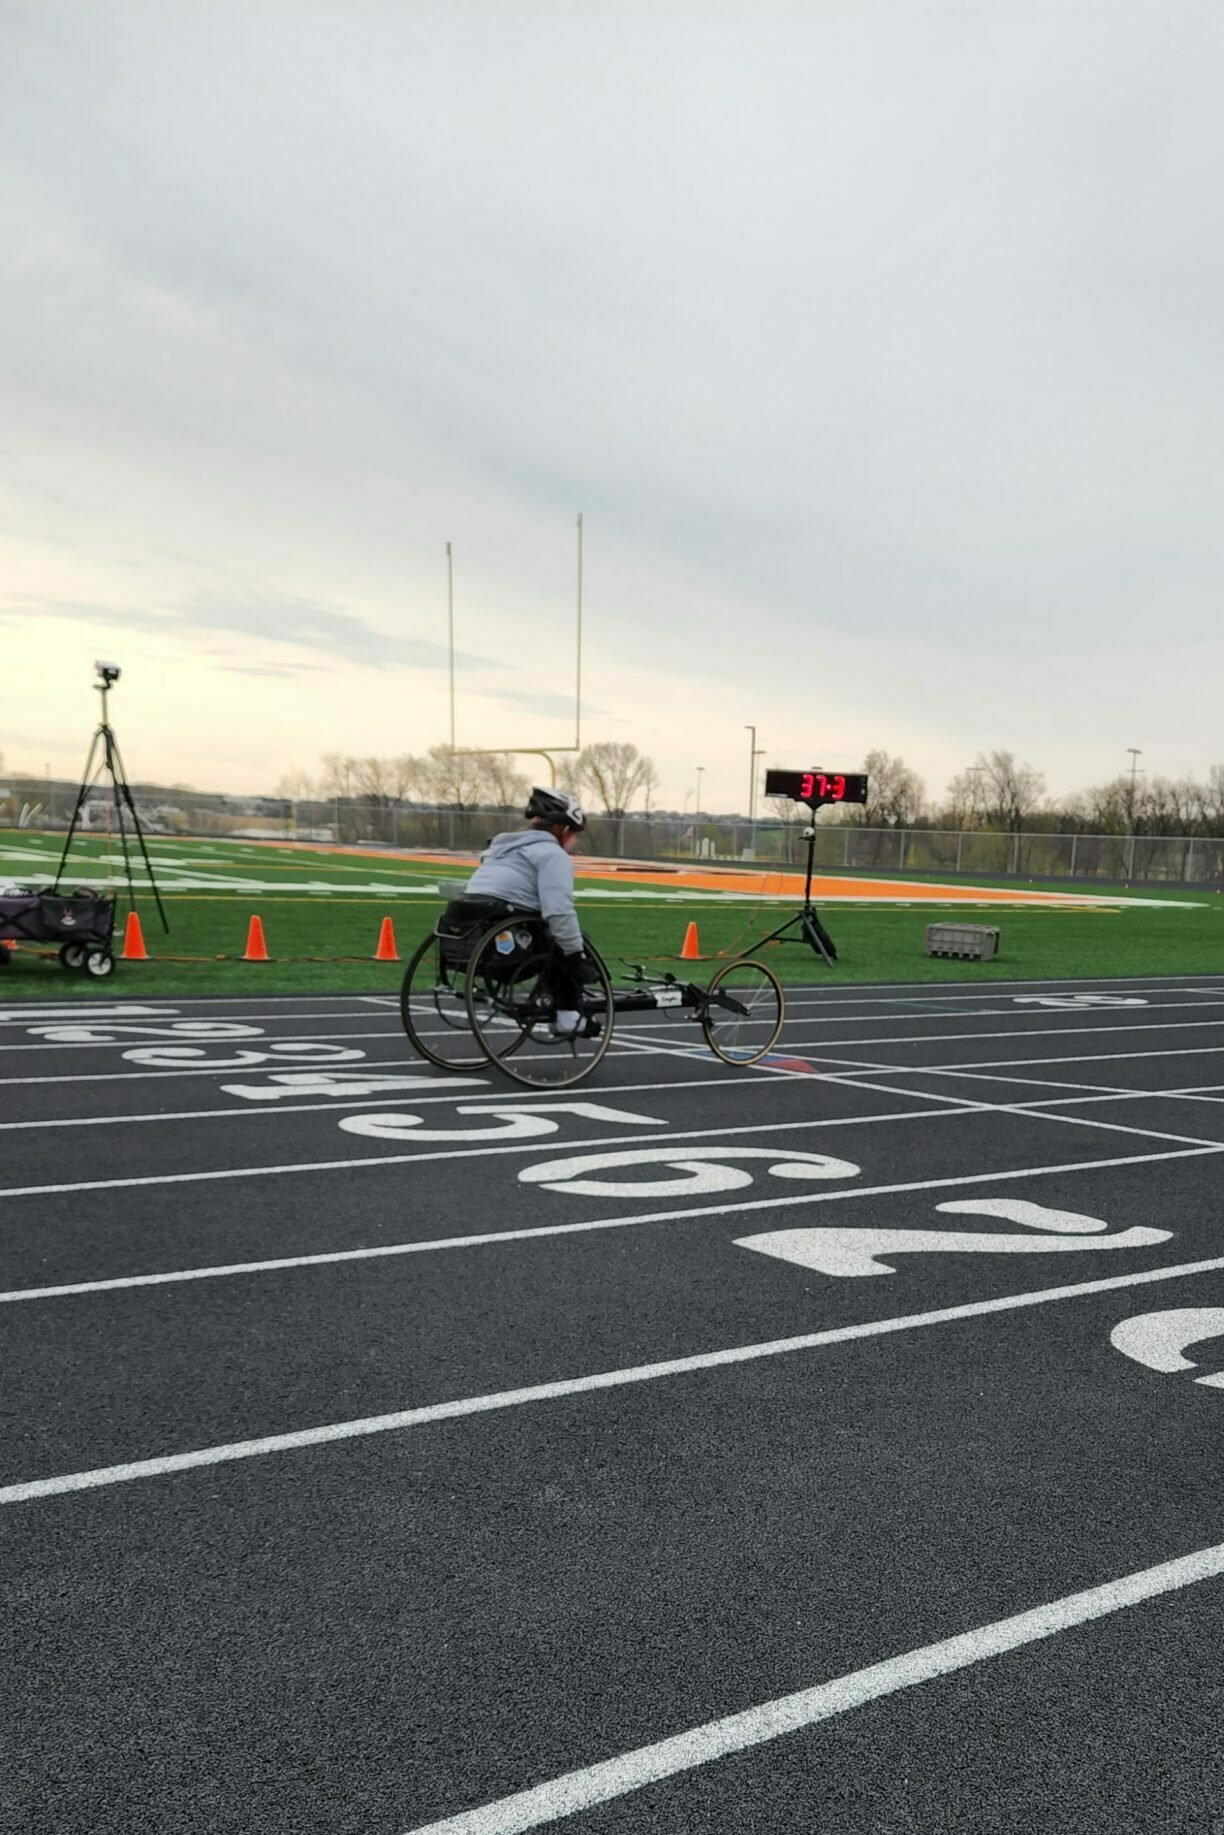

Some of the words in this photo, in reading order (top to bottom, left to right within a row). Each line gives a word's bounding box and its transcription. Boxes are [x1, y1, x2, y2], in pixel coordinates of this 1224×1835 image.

[26, 1021, 265, 1042] 2
[121, 1042, 366, 1068] 3
[220, 1072, 492, 1100] 4
[338, 1102, 669, 1141] 5
[518, 1147, 861, 1197] 6
[732, 1198, 1174, 1277] 7
